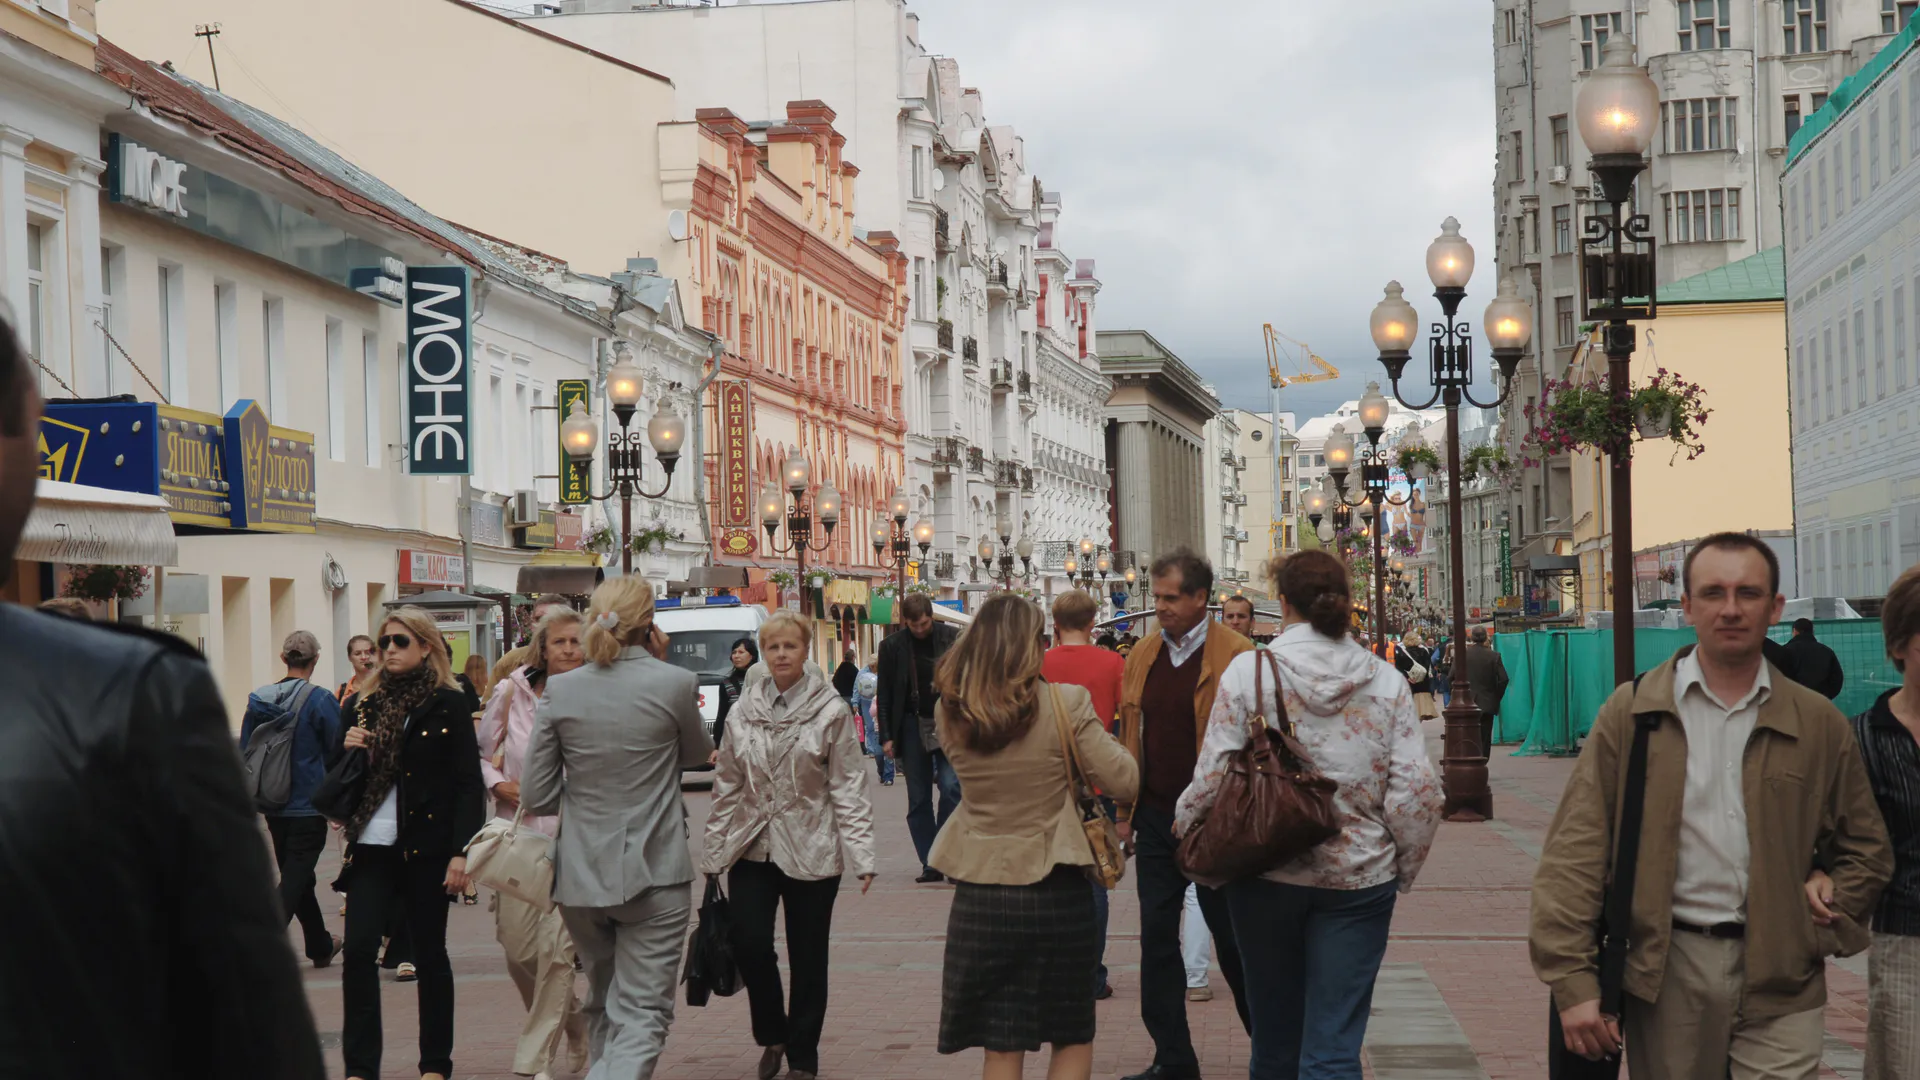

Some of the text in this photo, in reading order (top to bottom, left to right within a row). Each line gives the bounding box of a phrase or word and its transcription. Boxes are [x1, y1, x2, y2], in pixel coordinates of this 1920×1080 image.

[121, 143, 188, 218] МОНЕ
[412, 281, 463, 461] МОНЕ
[167, 432, 309, 492] ЯШМА ОЛОТО
[730, 392, 744, 516] АНТИКВАРИАТ
[427, 555, 448, 580] КАССА
[724, 531, 752, 541] СКУПКА
